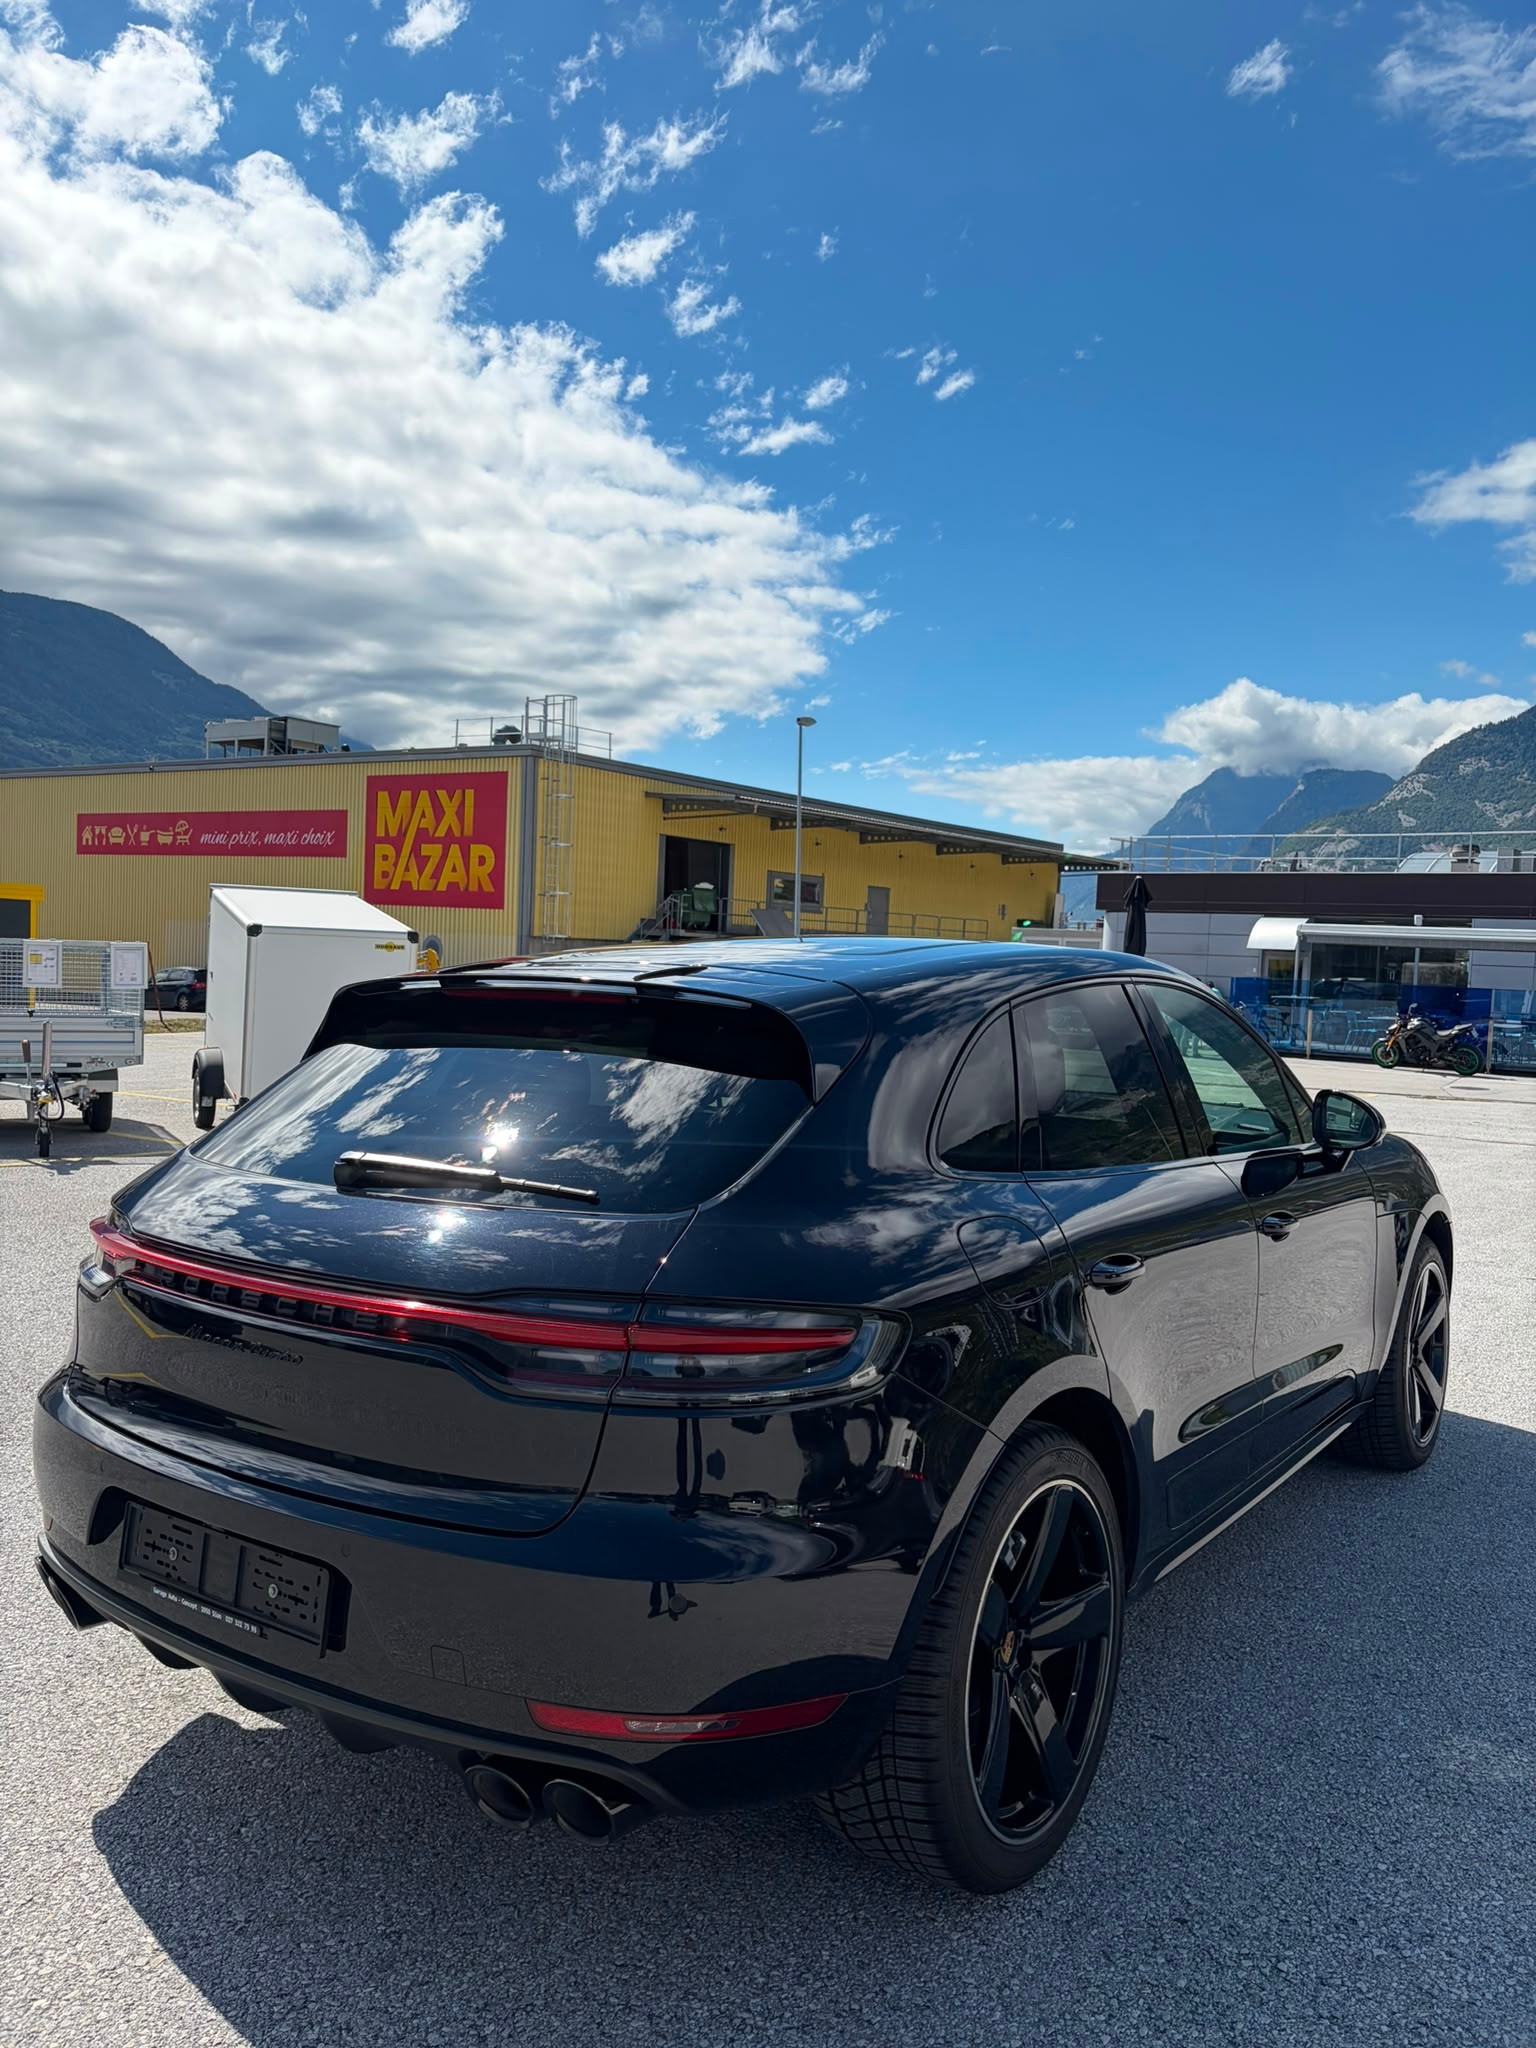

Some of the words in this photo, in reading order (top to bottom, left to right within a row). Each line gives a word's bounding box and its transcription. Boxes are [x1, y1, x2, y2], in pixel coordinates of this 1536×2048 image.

[375, 788, 475, 838] MAXI
[200, 830, 229, 845] mini
[228, 830, 262, 850] prix,
[264, 830, 299, 847] maxi
[300, 827, 336, 848] choix
[373, 843, 496, 892] BAZAR
[158, 1268, 379, 1330] PORSCHE
